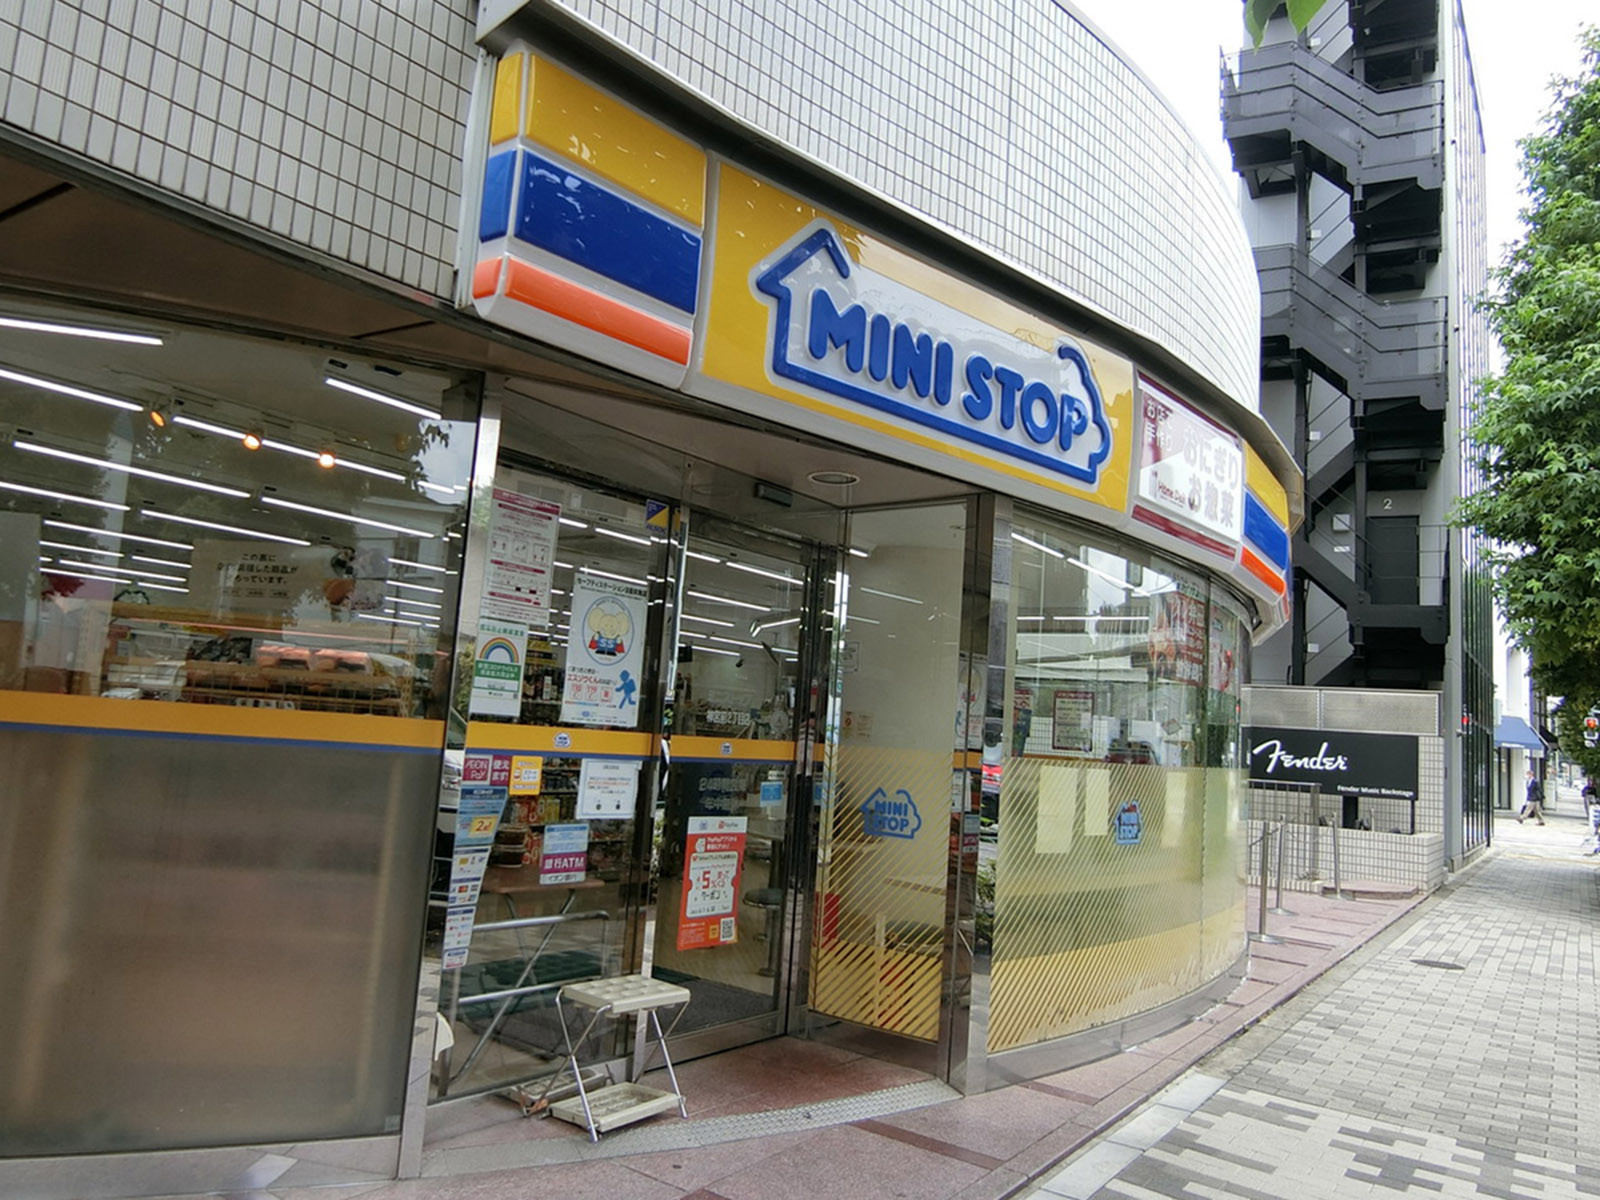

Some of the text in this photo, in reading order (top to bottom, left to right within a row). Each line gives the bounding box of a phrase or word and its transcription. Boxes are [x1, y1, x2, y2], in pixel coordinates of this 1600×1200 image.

[808, 288, 1088, 451] MINI STOP
[1183, 424, 1239, 491] おにぎり
[1383, 498, 1393, 510] 2
[1252, 739, 1348, 774] Fender
[875, 801, 908, 816] MINI
[545, 856, 585, 870] 銀行ATM
[702, 871, 711, 889] 5
